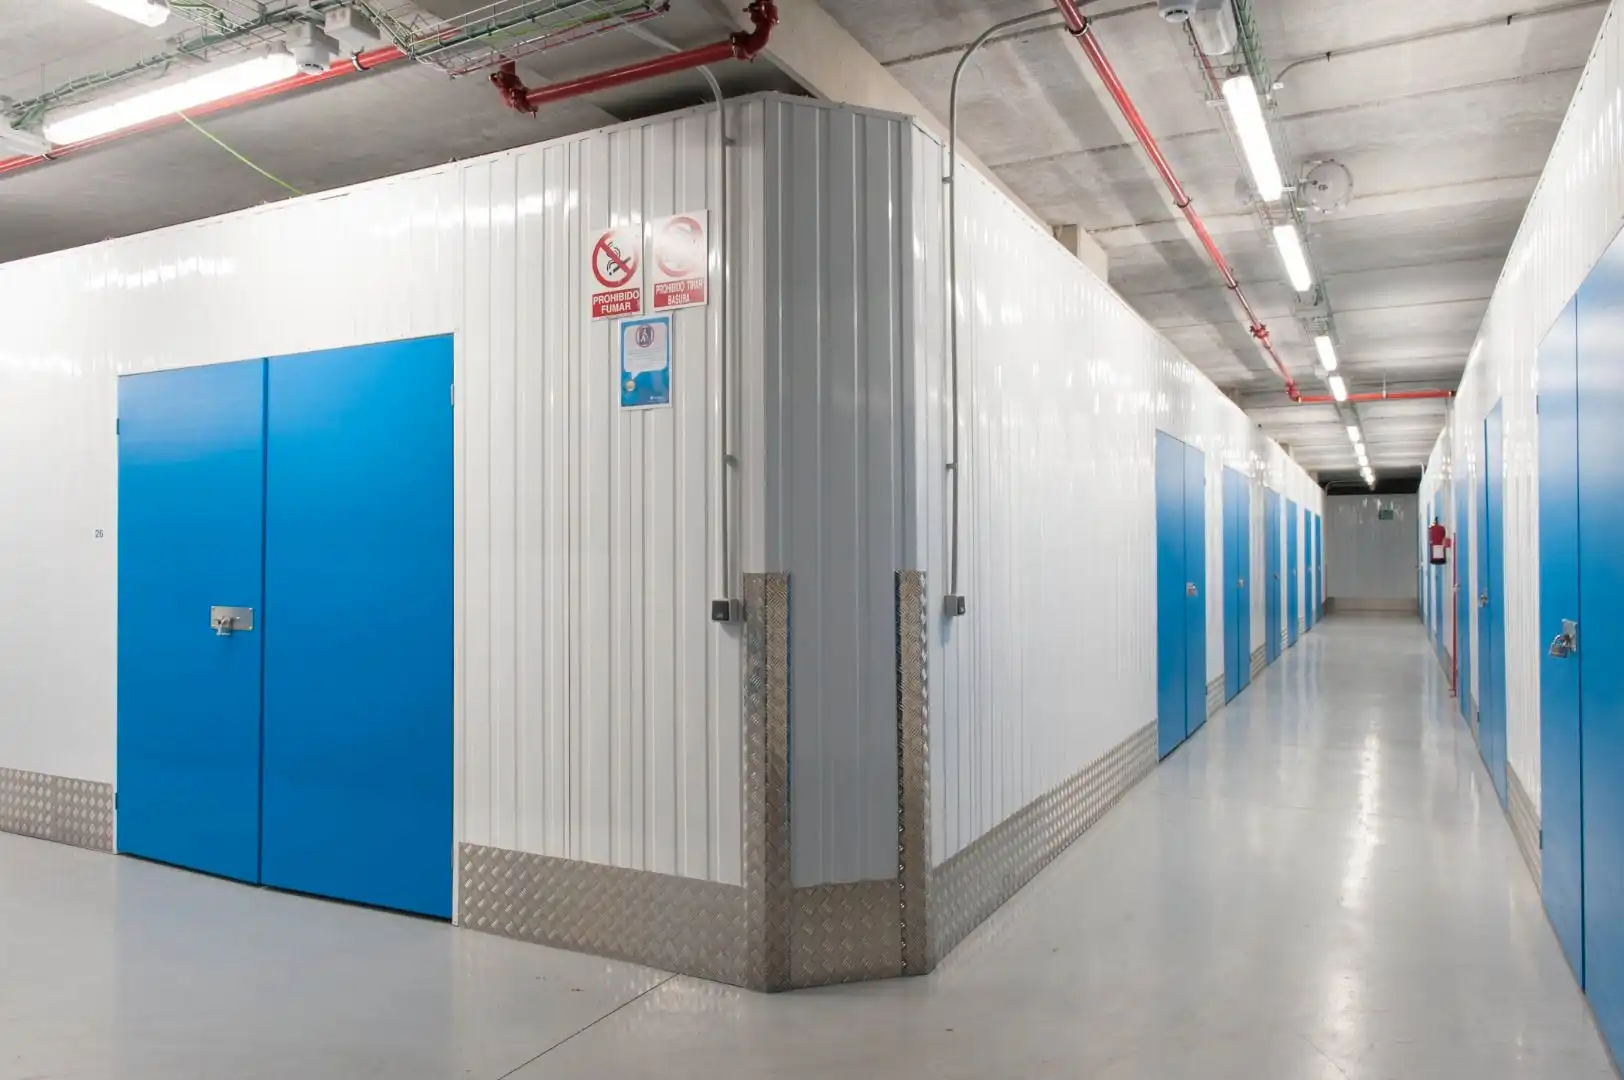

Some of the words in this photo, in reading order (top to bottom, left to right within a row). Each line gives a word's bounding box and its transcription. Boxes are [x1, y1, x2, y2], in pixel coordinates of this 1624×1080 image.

[656, 282, 685, 294] PROHIBIDO
[593, 291, 639, 304] PROHIBIDO
[667, 295, 690, 305] BASURA
[601, 302, 631, 314] FUMAR
[96, 530, 104, 538] 26
